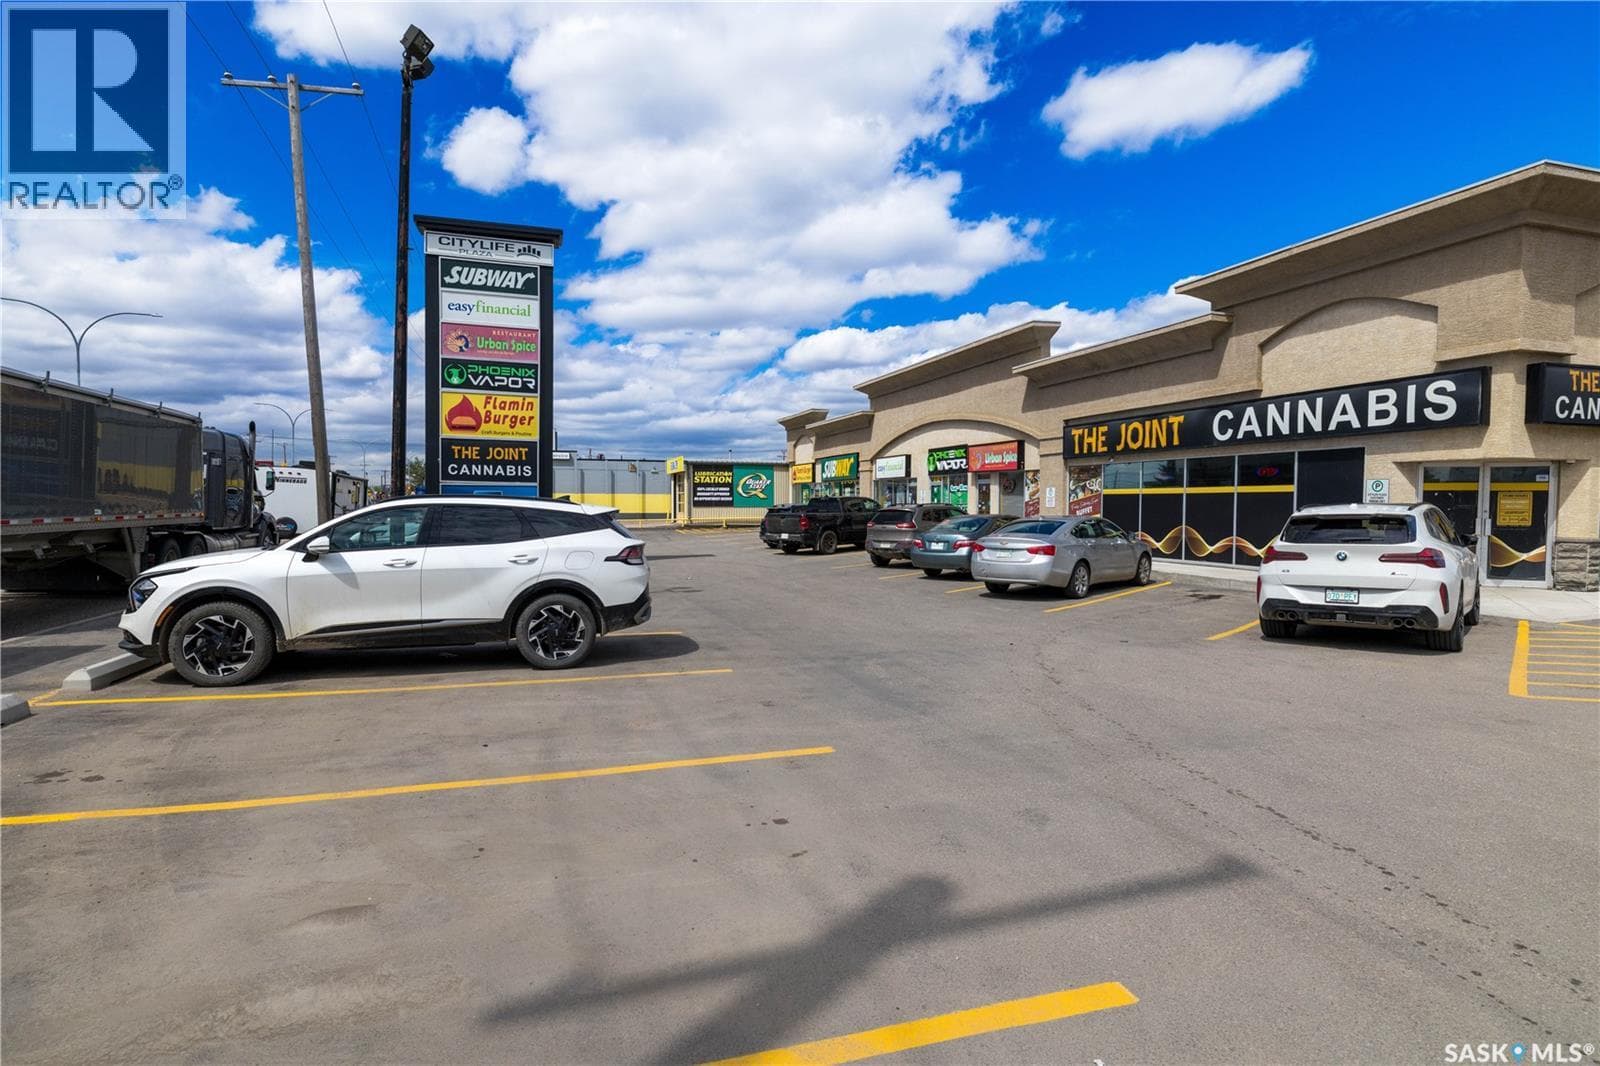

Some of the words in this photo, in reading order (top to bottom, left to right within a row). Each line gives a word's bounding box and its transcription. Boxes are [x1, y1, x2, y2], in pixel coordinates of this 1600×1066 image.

[438, 236, 515, 253] CITYLIFE
[459, 248, 493, 257] PLAZA
[443, 265, 536, 289] SUBWAY
[492, 330, 537, 339] RESTAURANT
[476, 336, 509, 351] Urban
[511, 338, 537, 353] Spice
[467, 364, 536, 378] PHOENIX
[468, 374, 536, 389] VAPOR
[1569, 369, 1600, 393] THE
[483, 395, 535, 412] Flamin
[483, 410, 535, 429] Burger
[1071, 425, 1108, 455] THE
[1116, 414, 1185, 452] JOINT
[1212, 379, 1458, 442] CANNABIS
[451, 445, 480, 459] THE
[486, 447, 529, 461] JOINT
[447, 464, 532, 477] CANNABIS
[822, 457, 854, 479] SUBWAY
[694, 476, 733, 484] STATION
